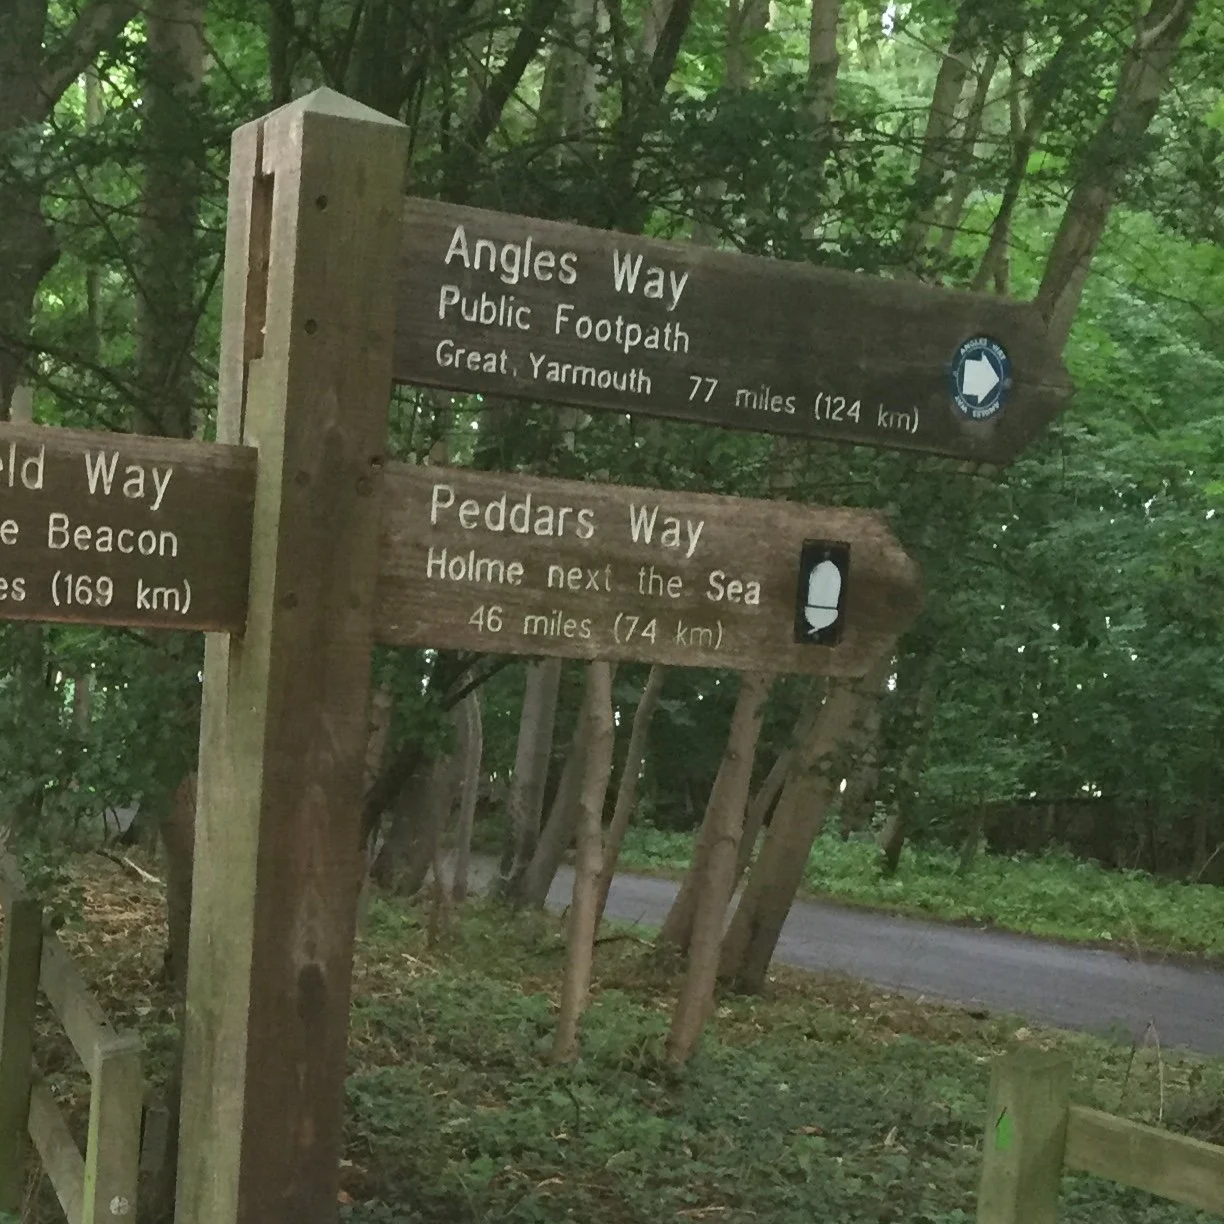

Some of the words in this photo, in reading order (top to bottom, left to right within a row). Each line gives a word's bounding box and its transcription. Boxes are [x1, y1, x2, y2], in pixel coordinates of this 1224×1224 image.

[445, 225, 578, 286] Angles
[612, 248, 689, 310] Way
[439, 285, 531, 330] Public
[556, 304, 690, 354] Footpath
[961, 338, 987, 355] ANGLES
[529, 352, 652, 396] Yarmouth
[689, 376, 718, 404] 77
[736, 386, 796, 415] miles
[814, 394, 861, 424] (124
[877, 404, 920, 433] km)
[85, 450, 173, 510] Way
[48, 513, 178, 557] Beacon
[431, 484, 595, 539] Peddars
[629, 503, 704, 558] Way
[52, 571, 114, 607] (169
[137, 578, 191, 614] km)
[427, 548, 524, 585] Holme
[548, 562, 613, 593] next
[639, 566, 682, 599] the
[706, 570, 761, 605] Sea
[469, 605, 502, 632] 46
[523, 608, 592, 640] miles
[614, 613, 656, 644] (74
[675, 620, 723, 648] km)
